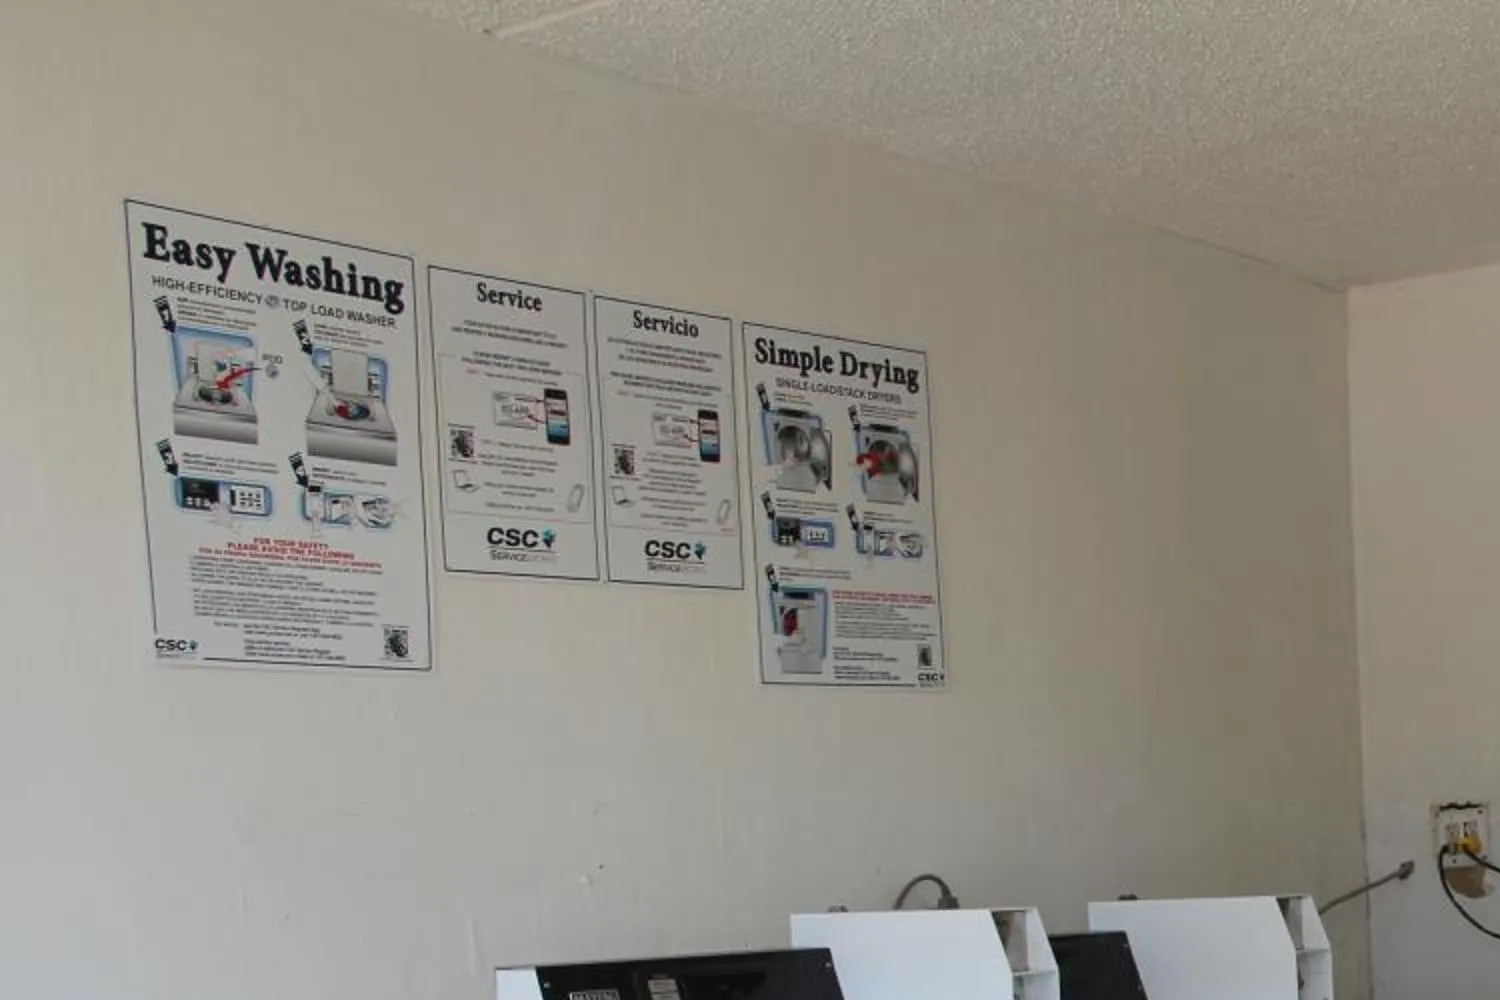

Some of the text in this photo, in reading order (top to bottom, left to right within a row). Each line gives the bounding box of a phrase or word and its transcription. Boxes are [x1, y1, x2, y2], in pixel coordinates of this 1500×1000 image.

[141, 222, 405, 315] Easy Washing
[152, 275, 263, 305] HIGH-EFFICIENCY
[283, 298, 307, 312] TOP
[311, 303, 344, 319] LOAD
[476, 281, 543, 312] Service
[632, 309, 700, 338] Servicio
[754, 336, 835, 377] Simple
[839, 350, 920, 394] Drying
[486, 526, 540, 548] CSC
[644, 539, 692, 559] CSC
[155, 638, 187, 651] CSC
